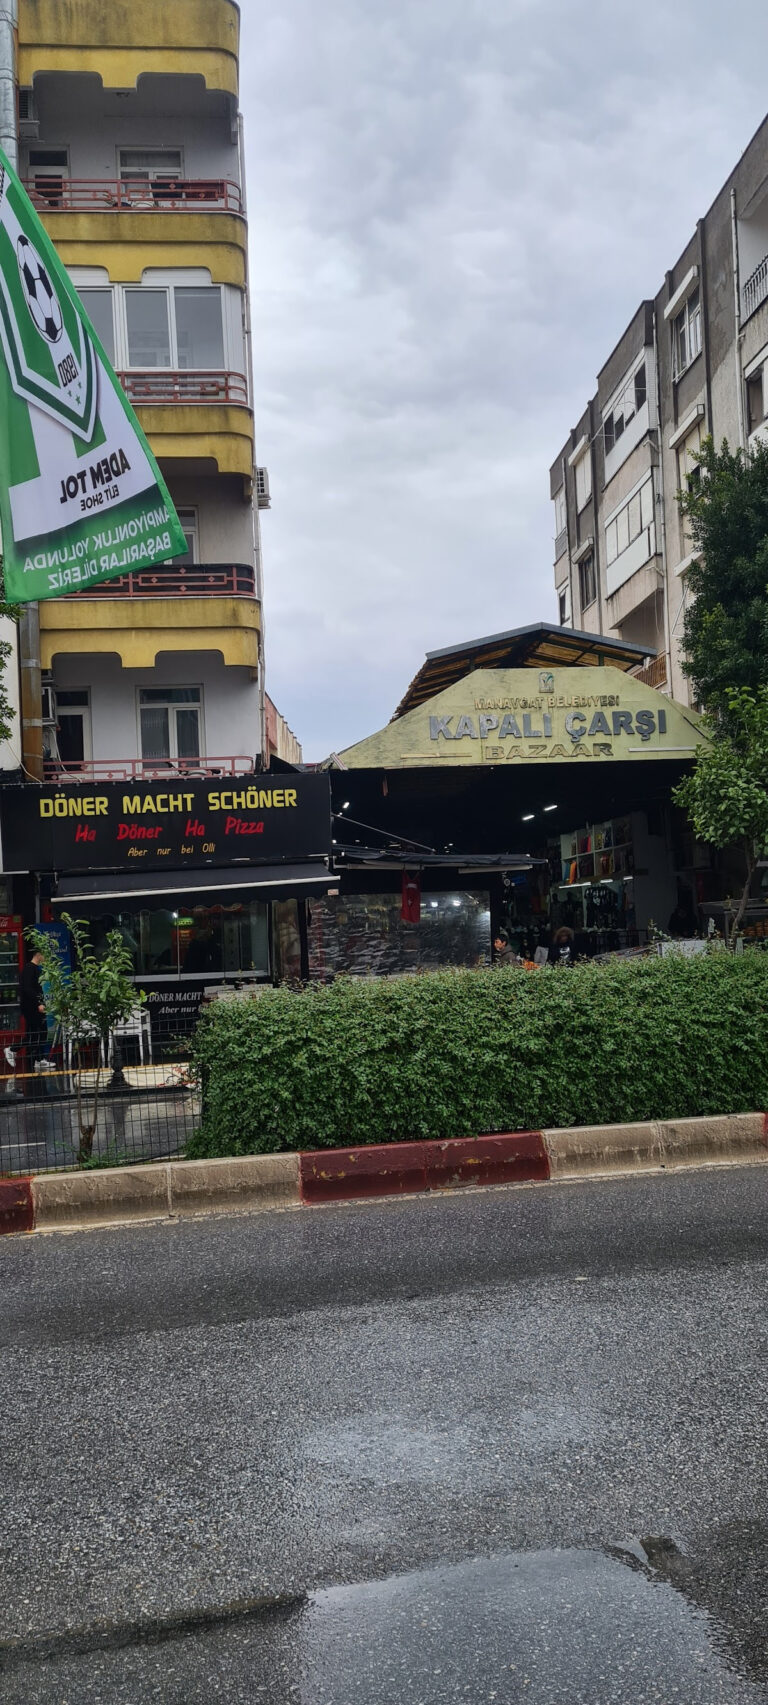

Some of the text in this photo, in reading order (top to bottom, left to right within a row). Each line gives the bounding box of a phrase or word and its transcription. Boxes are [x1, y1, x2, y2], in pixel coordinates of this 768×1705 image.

[474, 697, 544, 711] MANAVGAT
[429, 709, 667, 742] KAPALI ÇARŞI
[485, 743, 614, 760] BAZAAR
[40, 785, 298, 817] DÖNER MACHT SCHÖNER
[75, 816, 265, 843] Ha Döner Ha Pizza
[127, 847, 148, 857] Aber
[156, 847, 172, 856] nur
[148, 991, 202, 1003] DÖNER MACHT
[158, 1006, 180, 1014] Aber
